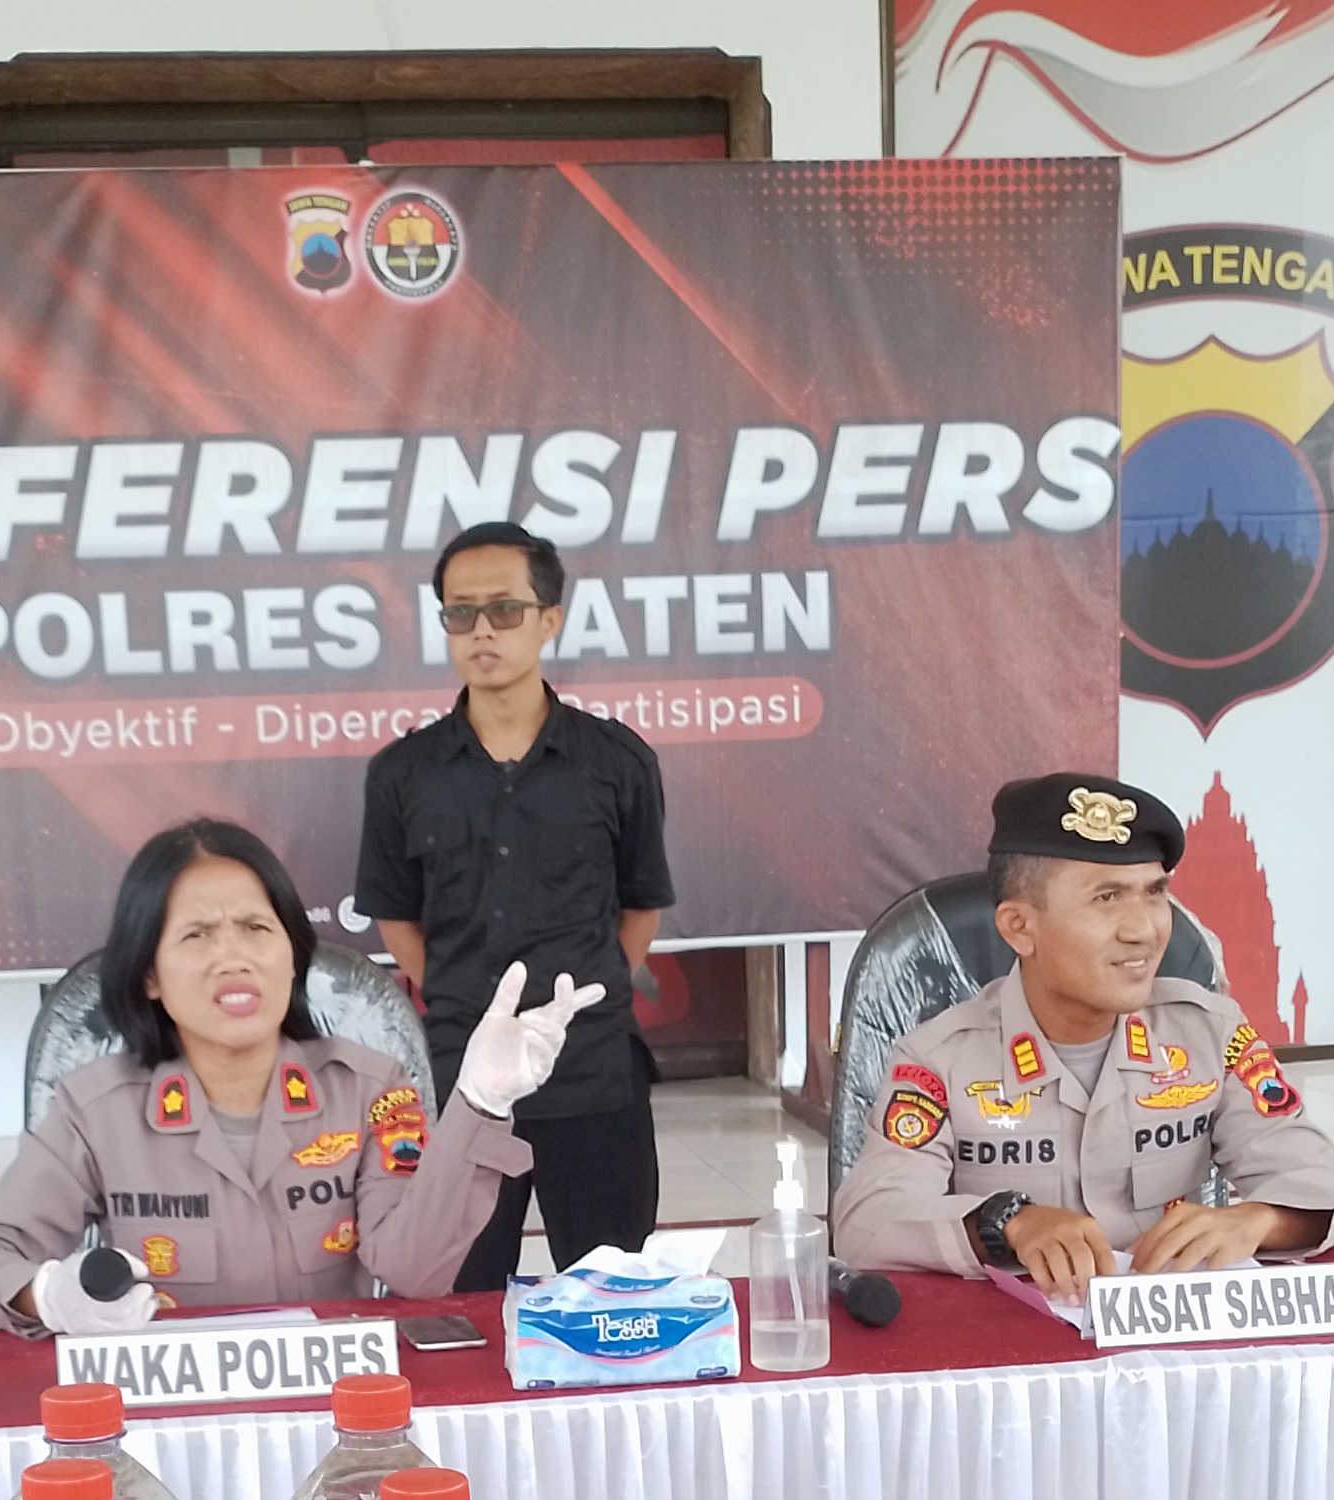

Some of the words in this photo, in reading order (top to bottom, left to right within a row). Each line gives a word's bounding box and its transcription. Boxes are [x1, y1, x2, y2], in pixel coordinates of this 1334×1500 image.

[715, 416, 1122, 543] PERS
[417, 569, 831, 666] ATEN
[254, 702, 452, 750] Diperca
[957, 1138, 1056, 1165] EDRIS
[109, 1192, 136, 1218] TRI
[285, 1174, 355, 1212] POL
[590, 1312, 660, 1343] Tessa
[1098, 1283, 1213, 1337] KASAT
[68, 1343, 205, 1396] WAKA
[216, 1331, 388, 1392] POLRES
